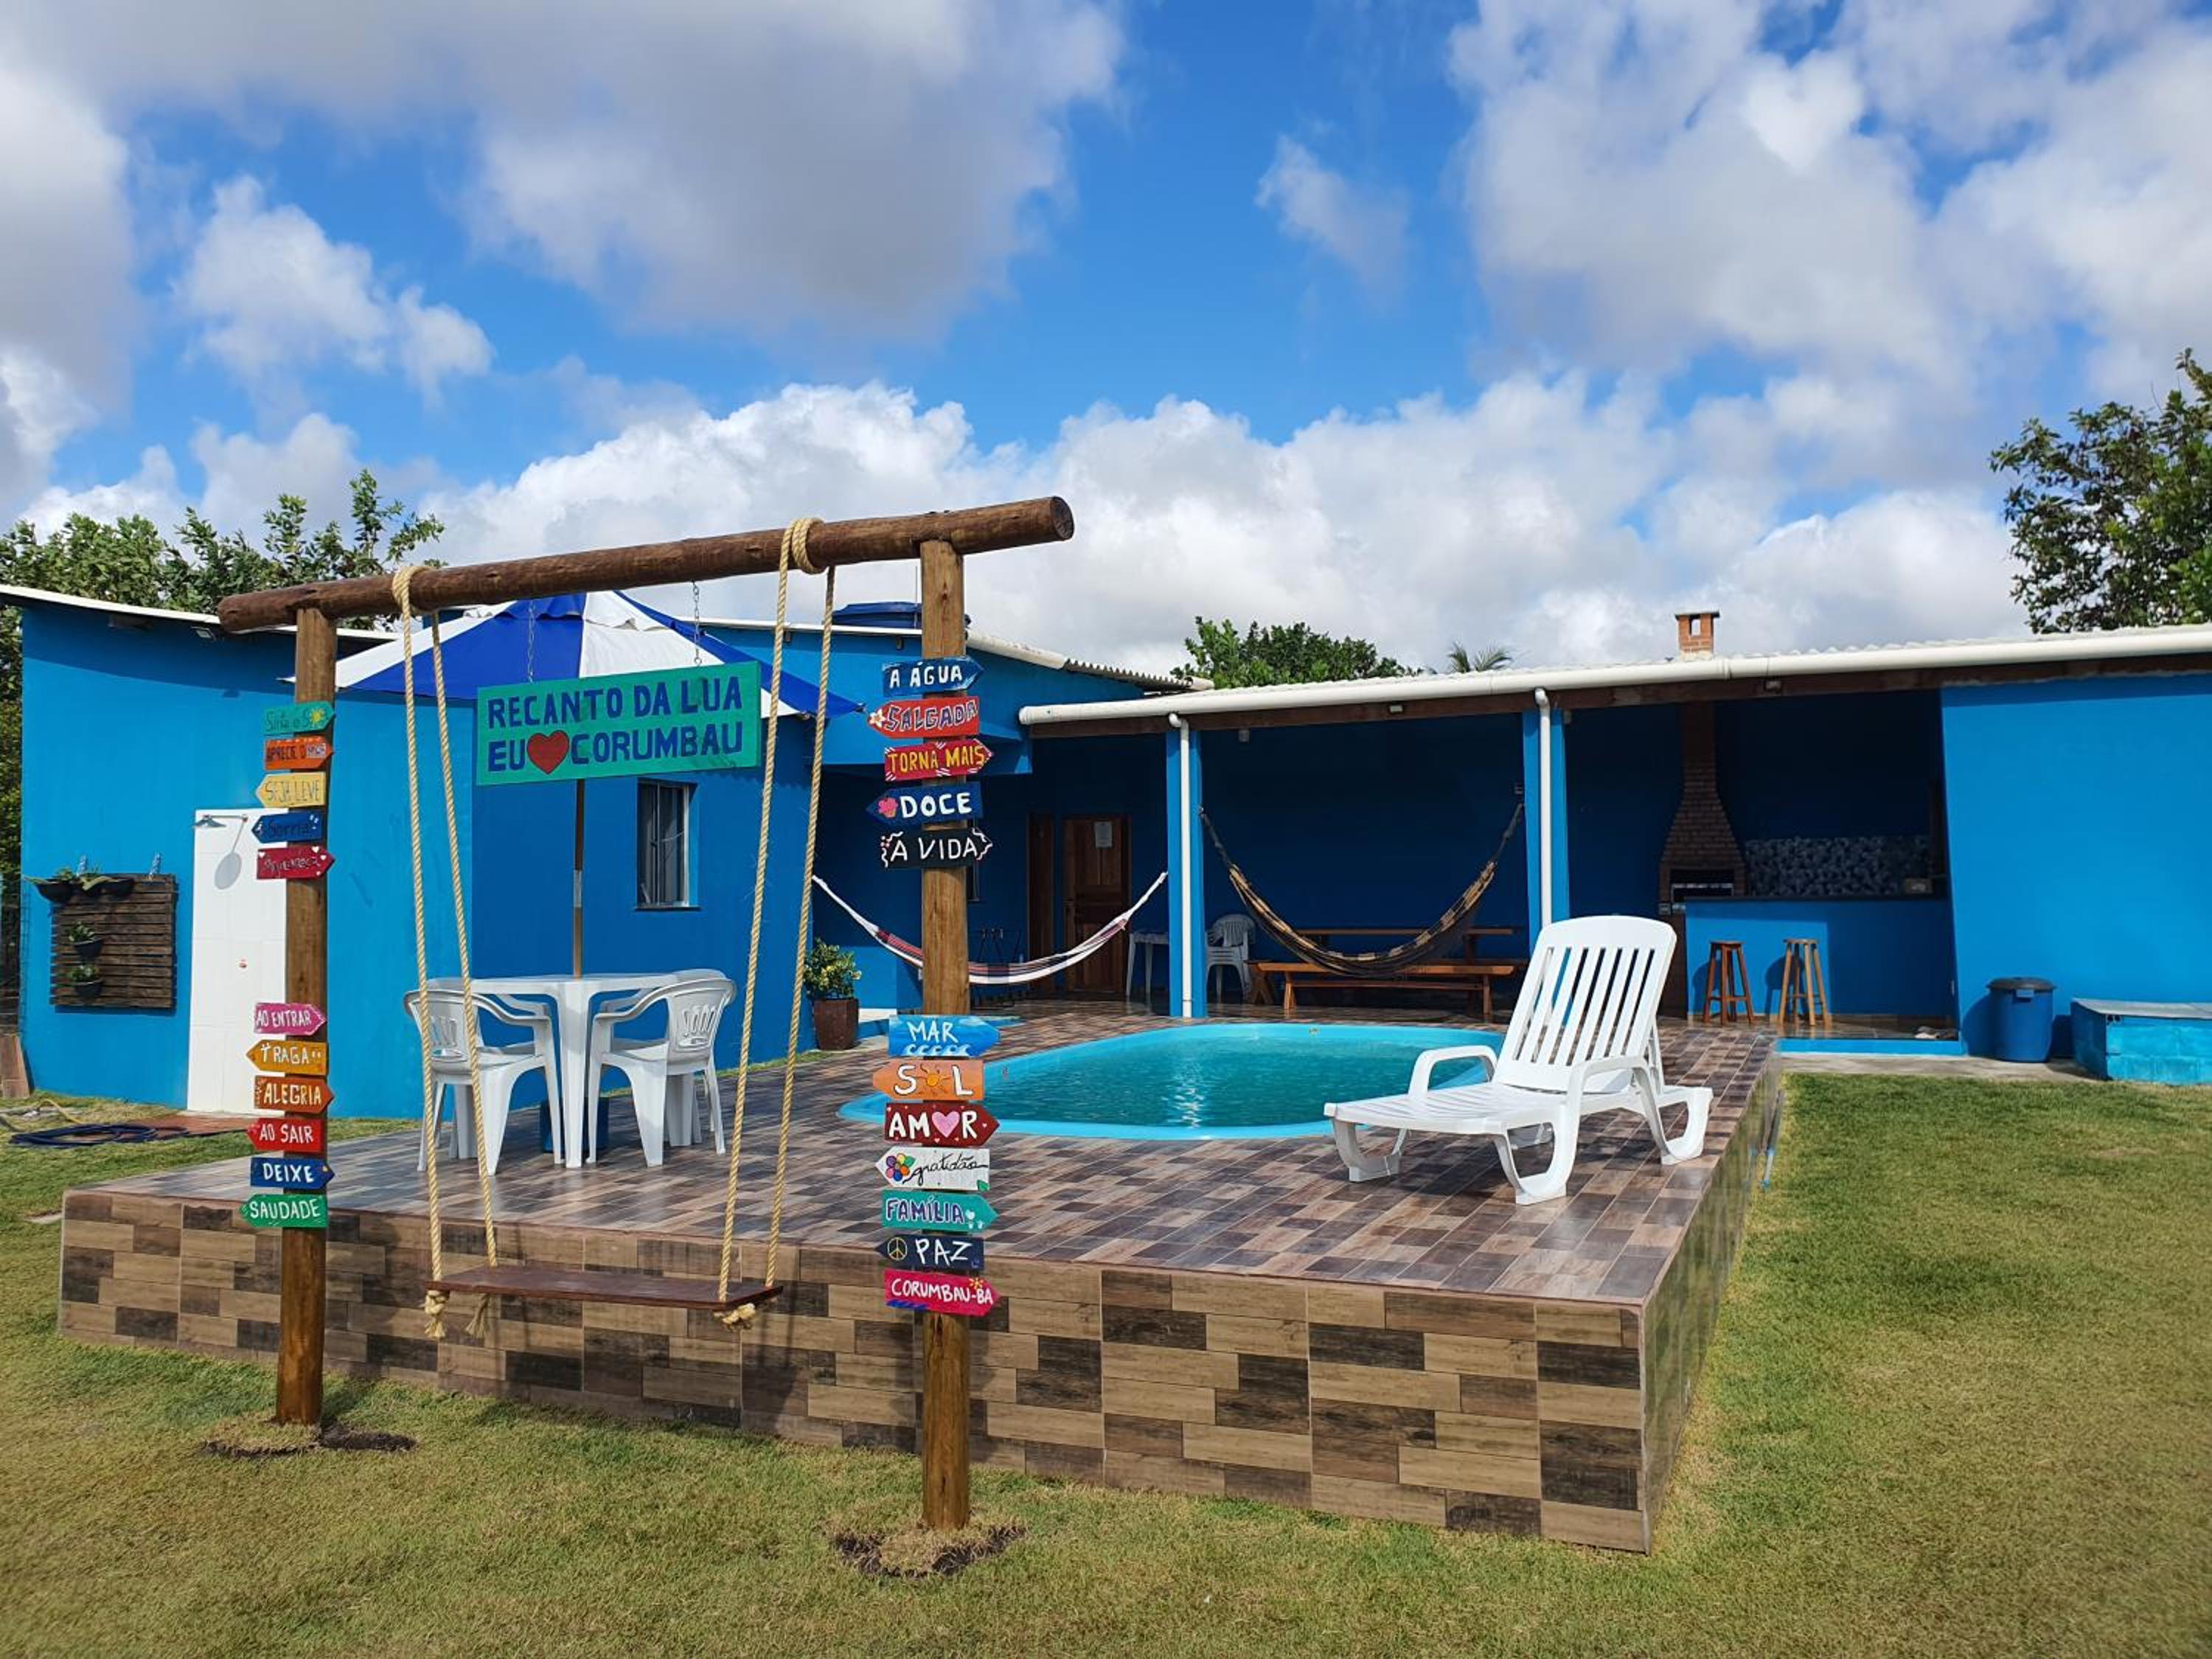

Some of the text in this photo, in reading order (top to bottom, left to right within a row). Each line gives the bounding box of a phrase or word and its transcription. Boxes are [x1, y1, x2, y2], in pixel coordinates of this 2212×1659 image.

[890, 669, 900, 688] A
[487, 676, 742, 728] RECANTO DA LUA
[488, 720, 742, 772] EU CORUMBAU
[888, 745, 984, 773] TORNA MAIS
[899, 792, 973, 818] DOCE
[918, 837, 978, 860] VIDA
[256, 1010, 311, 1027] AO ENTRAR
[907, 1022, 959, 1043] MAR
[261, 1043, 310, 1064] TRAGA
[263, 1082, 322, 1105] ALEGRIA
[260, 1124, 314, 1144] AO SAIR
[262, 1163, 314, 1183] DEIXE
[248, 1198, 321, 1219] SAUDADE
[915, 1238, 973, 1267] PAZ
